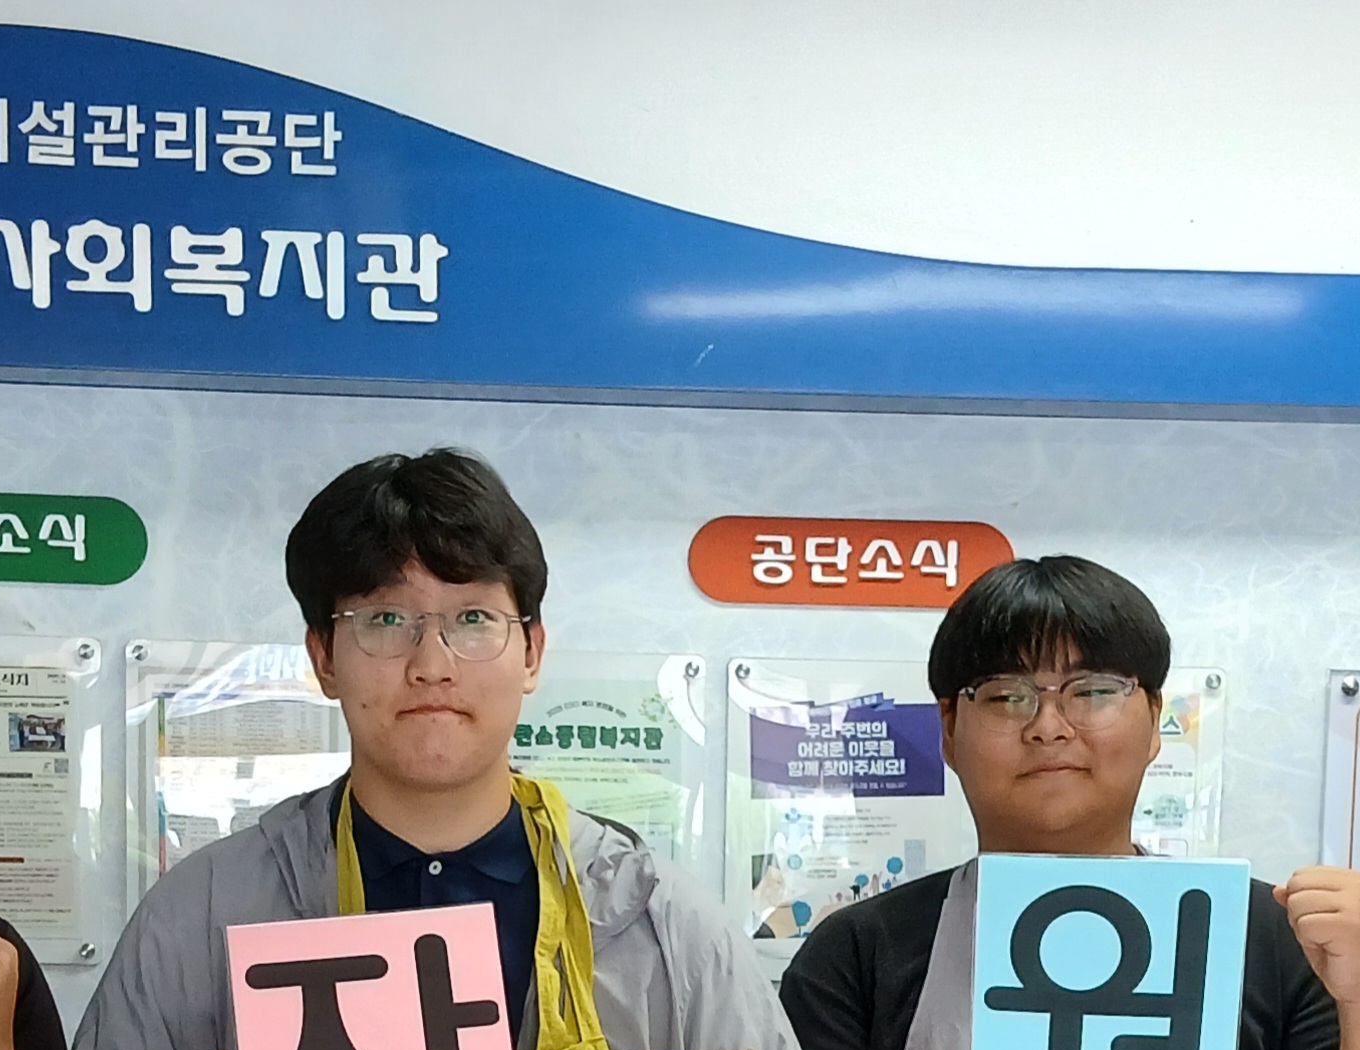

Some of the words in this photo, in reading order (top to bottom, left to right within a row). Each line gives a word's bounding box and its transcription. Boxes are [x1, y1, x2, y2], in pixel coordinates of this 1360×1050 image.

[750, 534, 960, 587] 공단소식
[839, 721, 888, 739] 주변의
[797, 741, 845, 758] 어려운
[848, 740, 895, 758] 이웃을
[787, 760, 820, 777] 함께
[823, 758, 906, 777] 찾아주세요!
